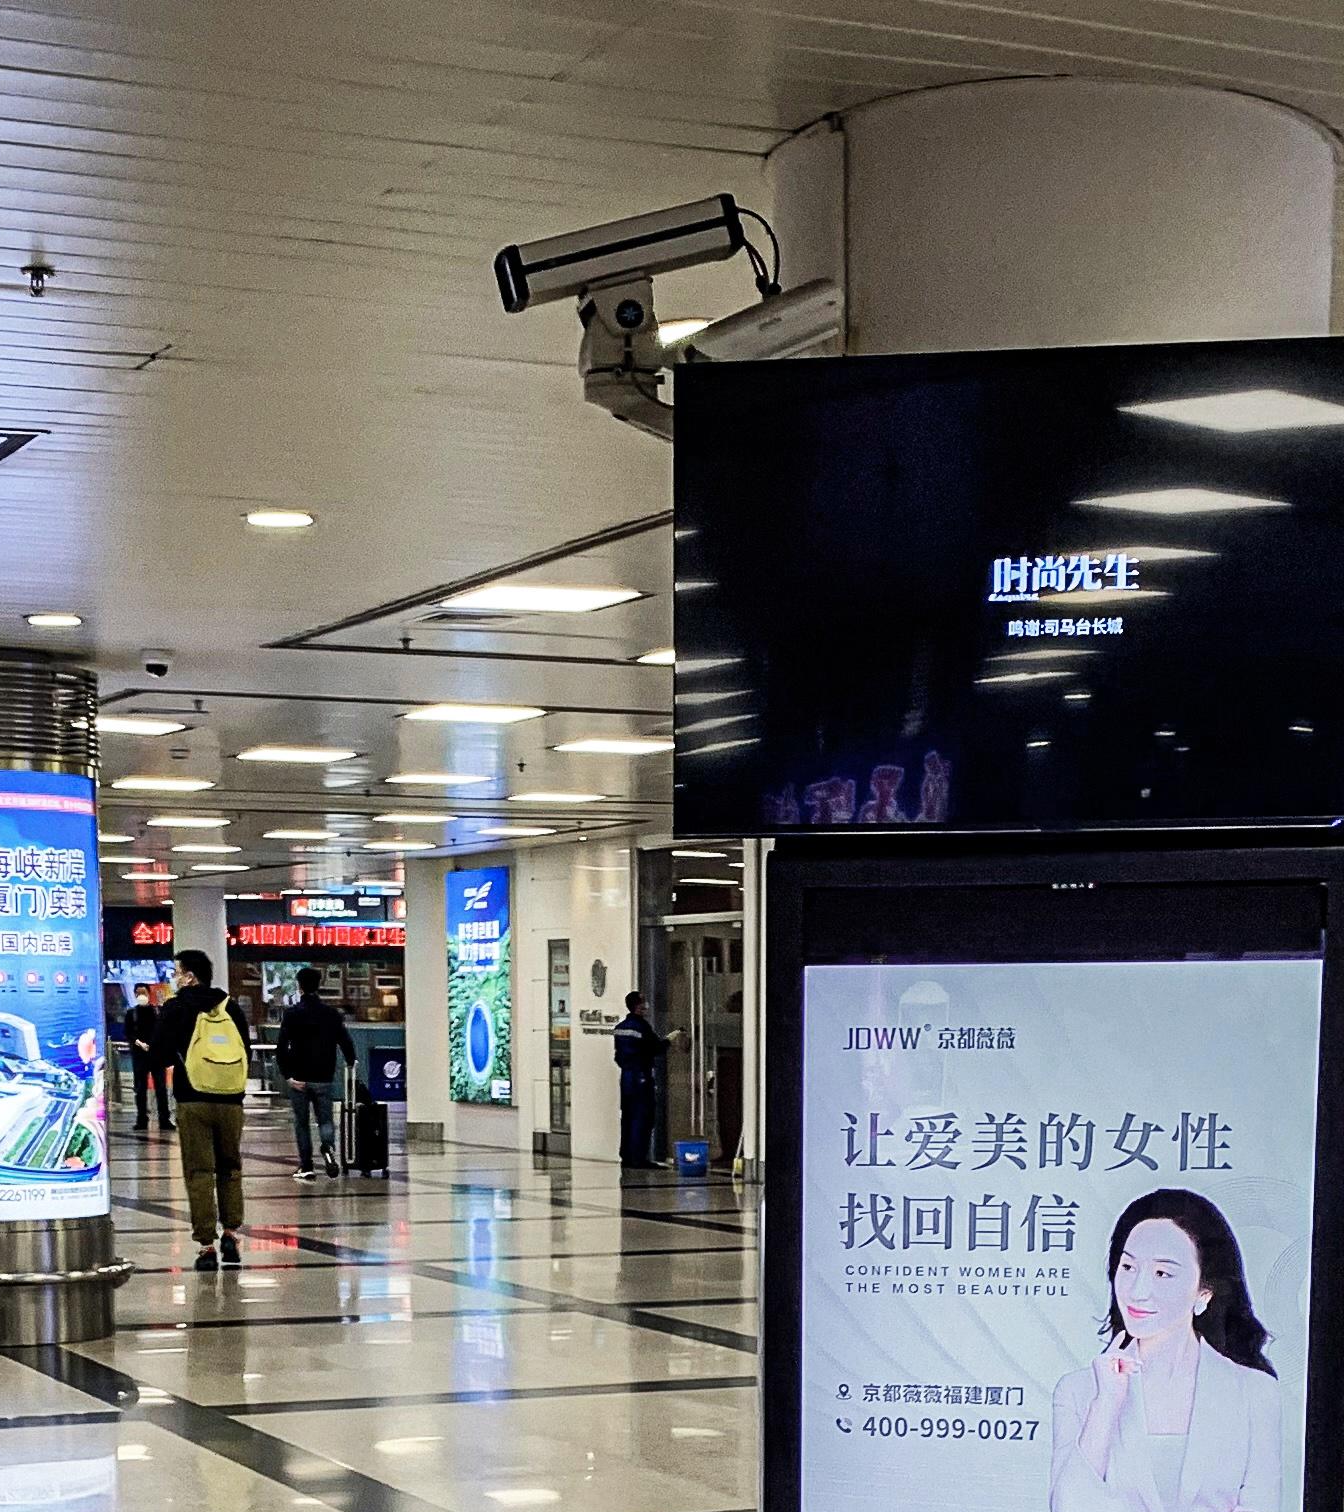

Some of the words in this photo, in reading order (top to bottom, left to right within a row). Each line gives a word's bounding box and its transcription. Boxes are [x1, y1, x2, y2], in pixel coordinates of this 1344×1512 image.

[993, 553, 1140, 593] 时尚先生
[843, 1027, 921, 1050] JDWW
[937, 1027, 1016, 1050] 京都薇薇
[840, 1112, 1233, 1171] 让爱美的女性
[839, 1192, 1080, 1253] 找回自信
[845, 1265, 949, 1277] CONFIDENT
[959, 1266, 1026, 1279] WOMEN
[1035, 1267, 1071, 1279] ARE
[846, 1283, 881, 1294] THE
[892, 1283, 945, 1295] MOST
[957, 1284, 1069, 1297] BEAUTIFUL
[862, 1383, 1024, 1406] 京都薇薇福建厦门
[862, 1416, 1040, 1441] 400-999-0027
